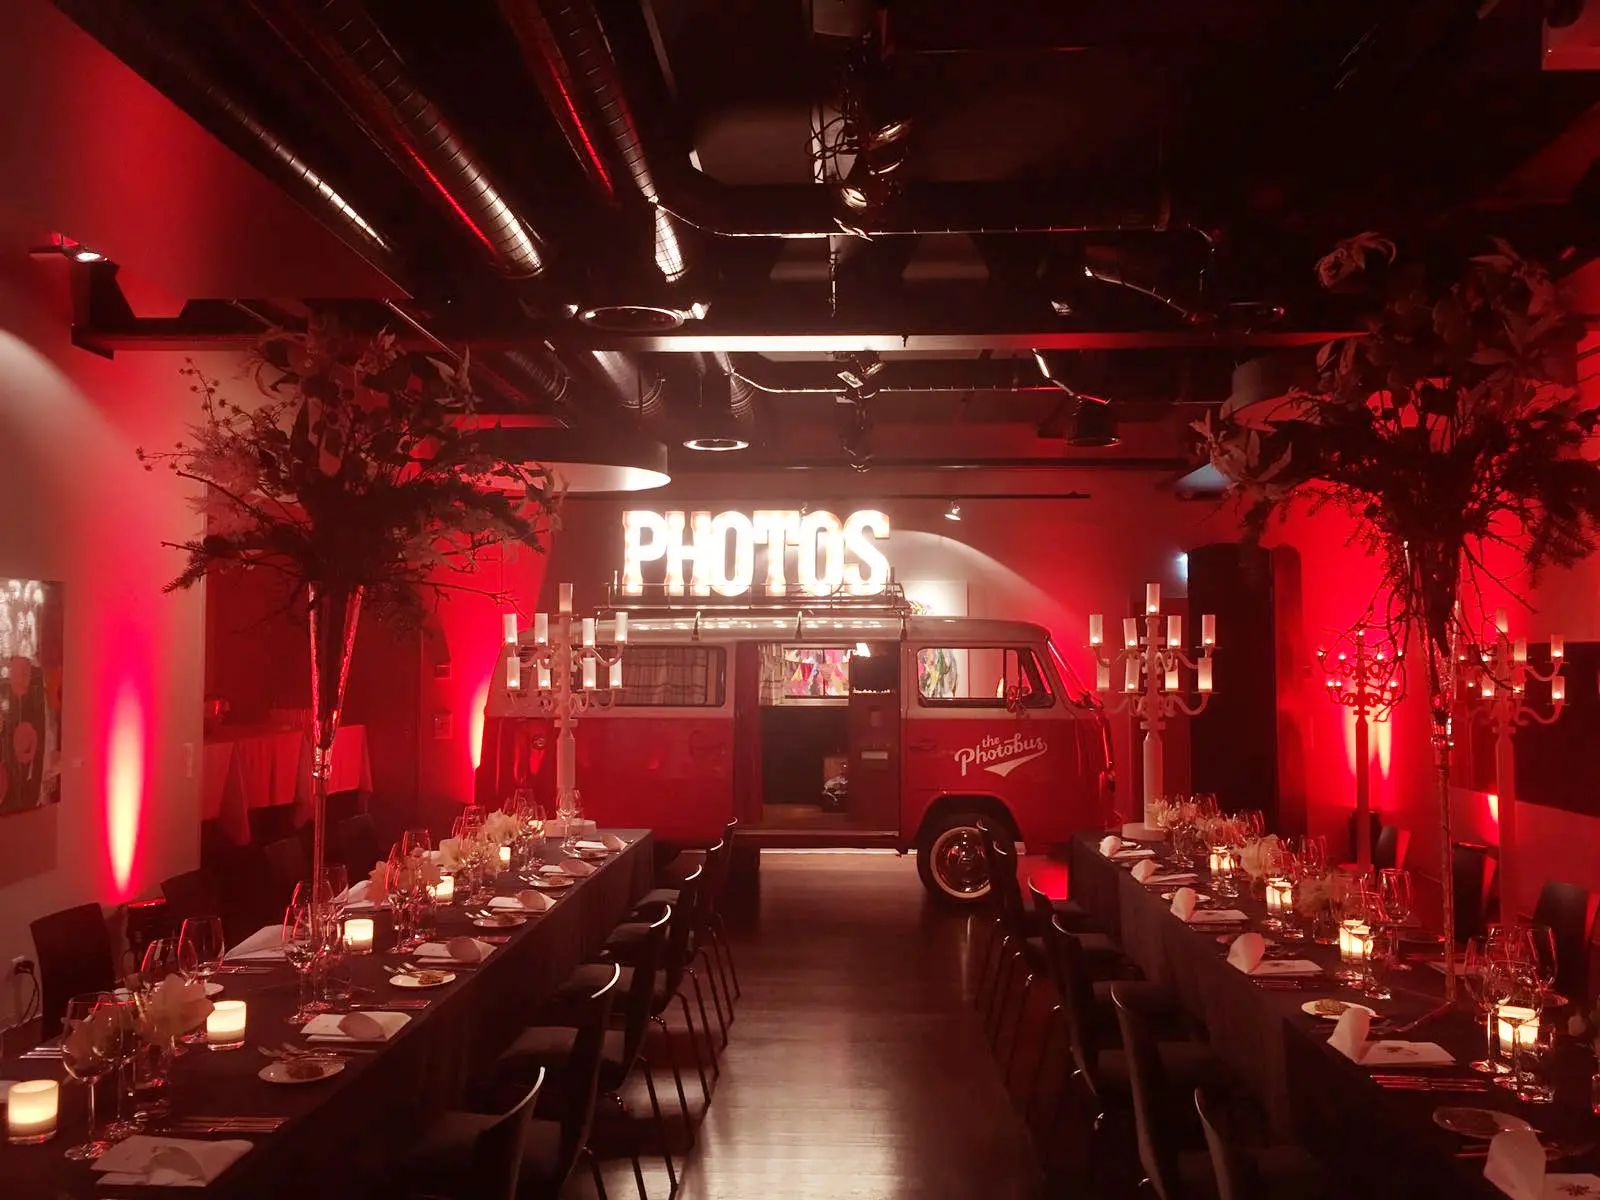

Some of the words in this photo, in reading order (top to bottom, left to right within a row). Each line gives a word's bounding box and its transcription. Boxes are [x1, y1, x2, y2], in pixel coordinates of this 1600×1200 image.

[622, 509, 890, 597] PHOTOS
[954, 733, 1047, 776] Photobus
[982, 734, 1000, 748] the
